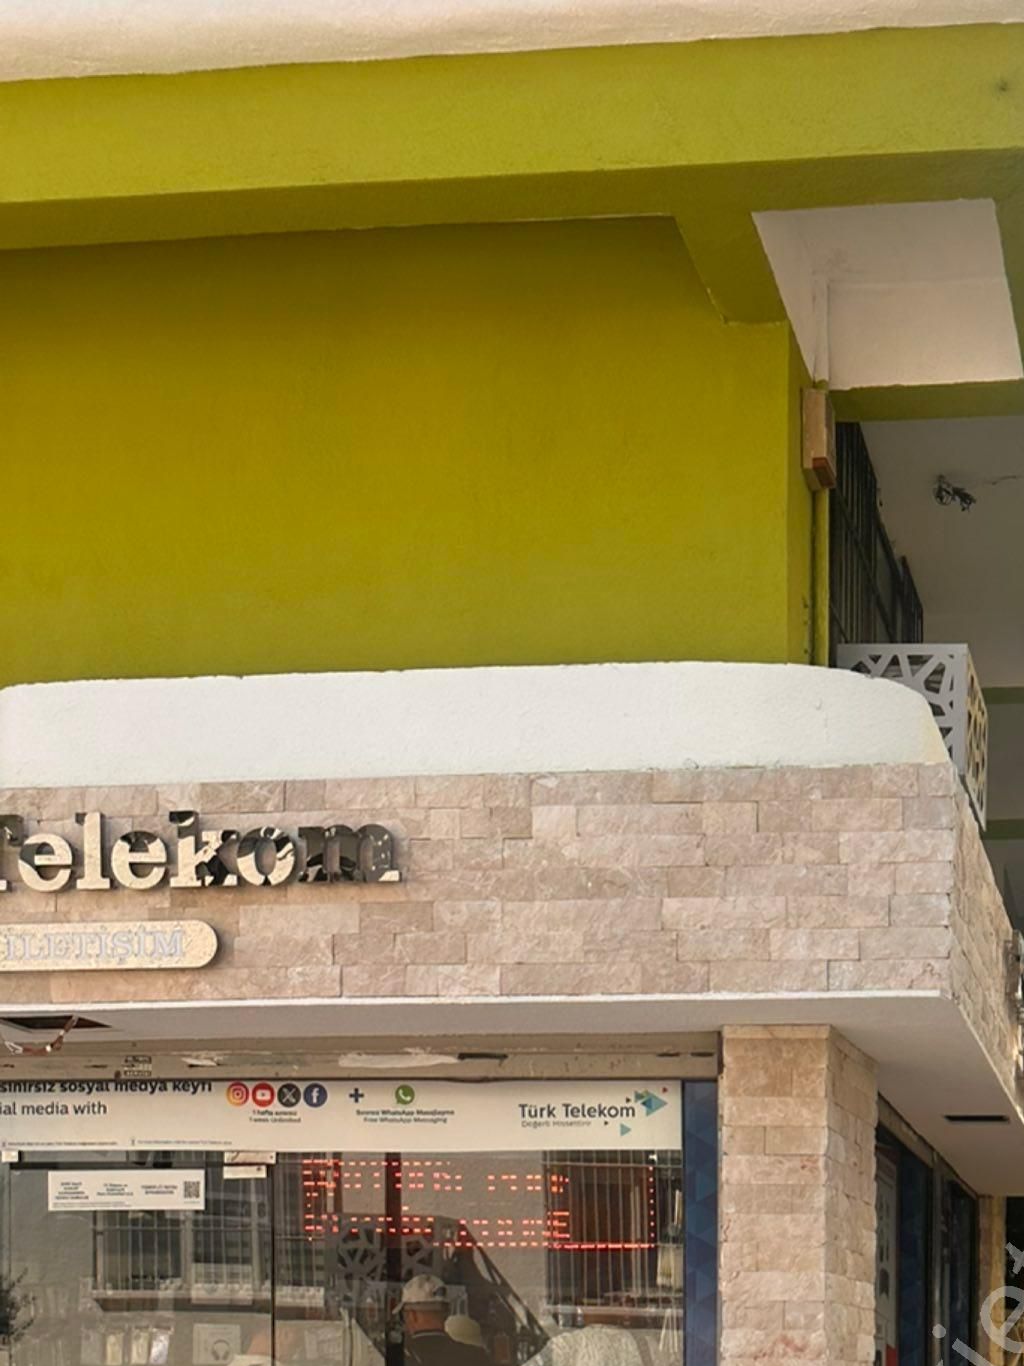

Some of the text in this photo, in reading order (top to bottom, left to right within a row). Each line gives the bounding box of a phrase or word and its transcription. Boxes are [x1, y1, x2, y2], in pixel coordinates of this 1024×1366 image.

[22, 1101, 69, 1115] media
[73, 1101, 108, 1115] with
[518, 1103, 636, 1118] Türk Telekom
